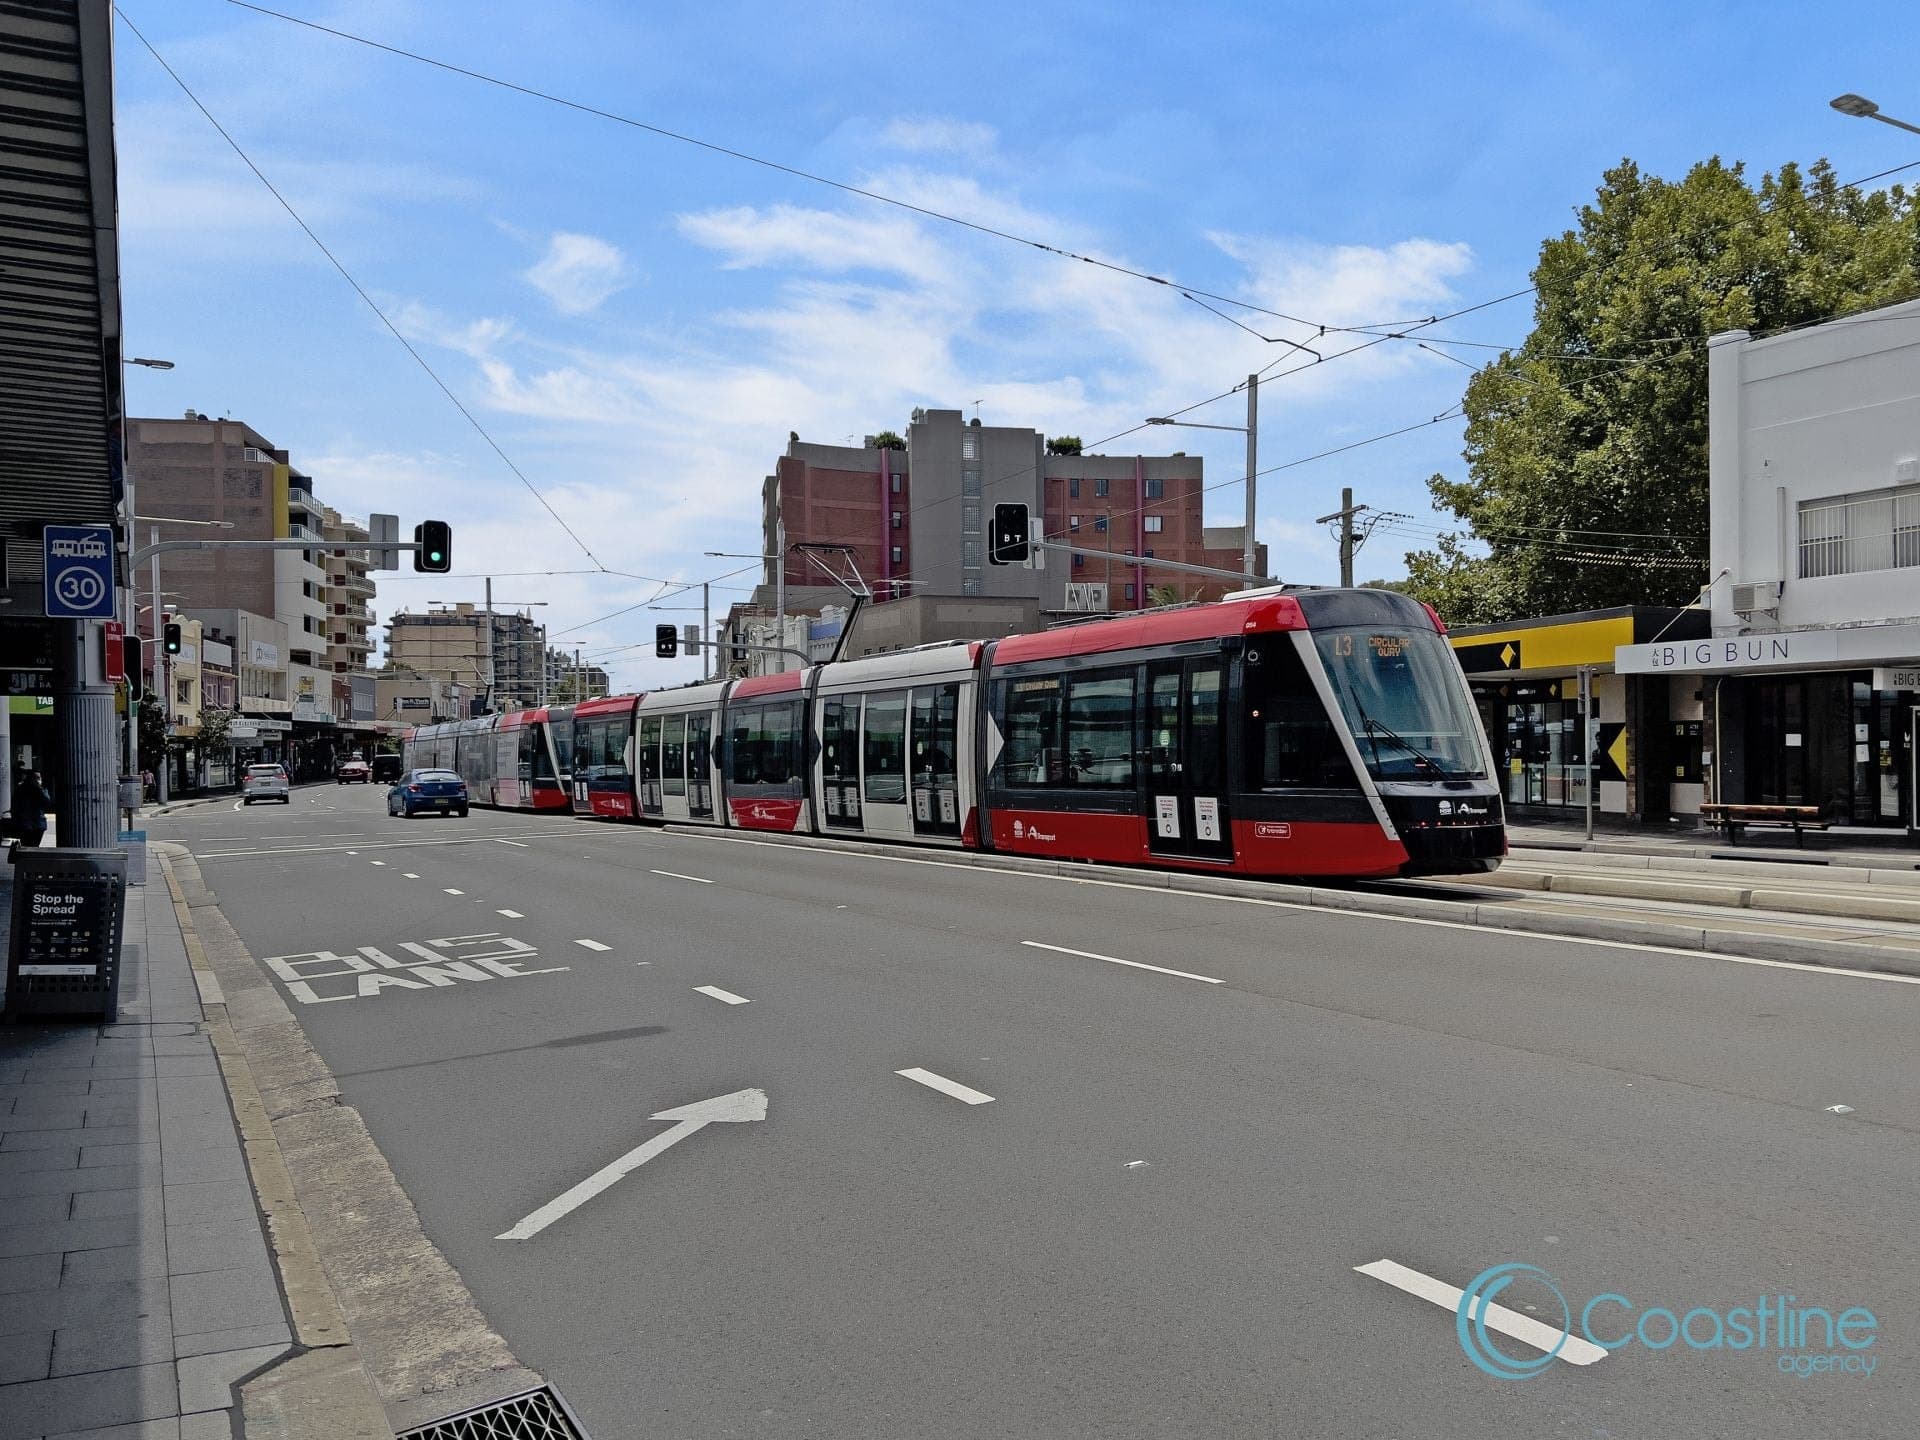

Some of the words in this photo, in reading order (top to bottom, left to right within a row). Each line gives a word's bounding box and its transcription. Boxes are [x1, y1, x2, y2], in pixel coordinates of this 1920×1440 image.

[1004, 534, 1010, 542] B
[1014, 534, 1021, 542] T
[63, 577, 97, 598] 30
[1335, 635, 1352, 656] L3
[1369, 637, 1410, 648] CIRCULAR
[1663, 643, 1711, 666] BIG
[1726, 639, 1788, 662] BUN
[1898, 673, 1914, 686] BIG
[37, 696, 54, 705] TAB
[33, 893, 62, 905] Stop
[65, 894, 84, 904] the
[32, 904, 76, 916] Spread
[262, 932, 538, 981] BUS
[285, 953, 571, 1004] LANE
